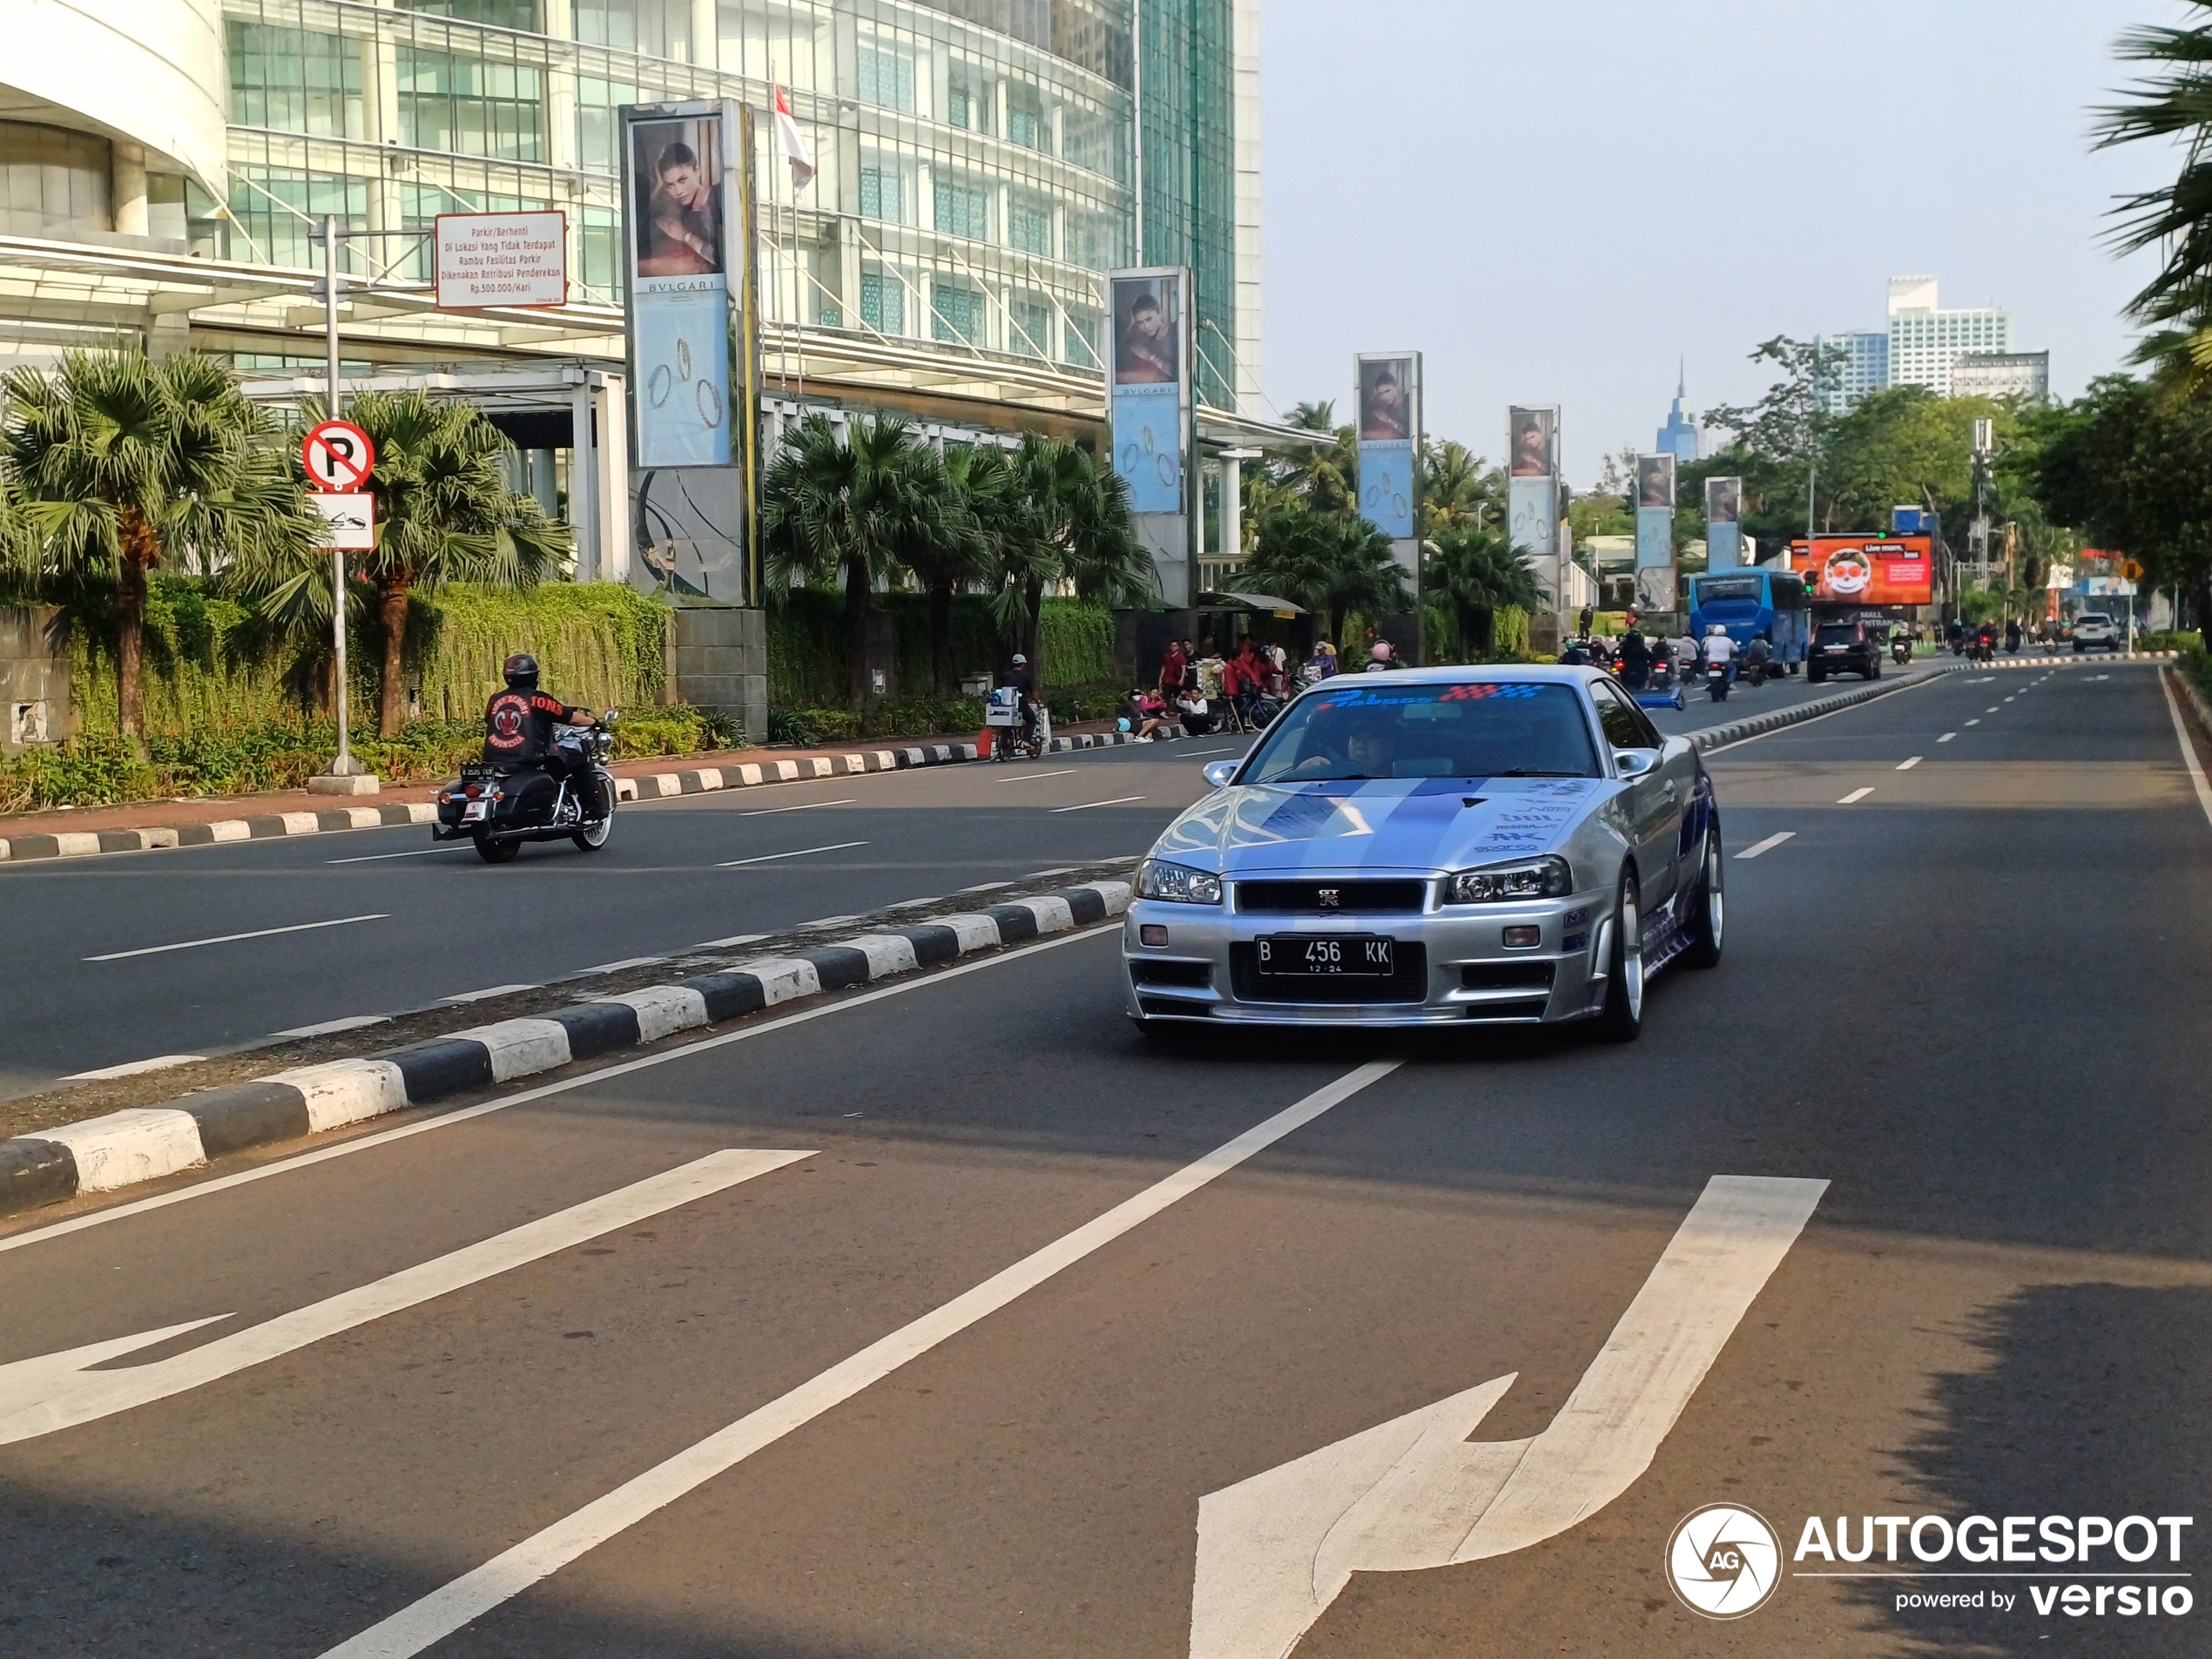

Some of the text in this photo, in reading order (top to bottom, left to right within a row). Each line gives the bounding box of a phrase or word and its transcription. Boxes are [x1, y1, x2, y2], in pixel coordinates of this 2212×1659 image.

[471, 226, 528, 237] Parkir/Berhenti
[445, 239, 556, 253] Di Lokasi Yang Tidak Terdapat
[459, 254, 542, 266] Rambu Fasilitas Parkir
[441, 267, 560, 280] Dikenakan Retribusi Penderekan
[649, 280, 714, 292] BVLGARI
[1319, 895, 1339, 906] R
[1259, 941, 1389, 963] B 456 KK
